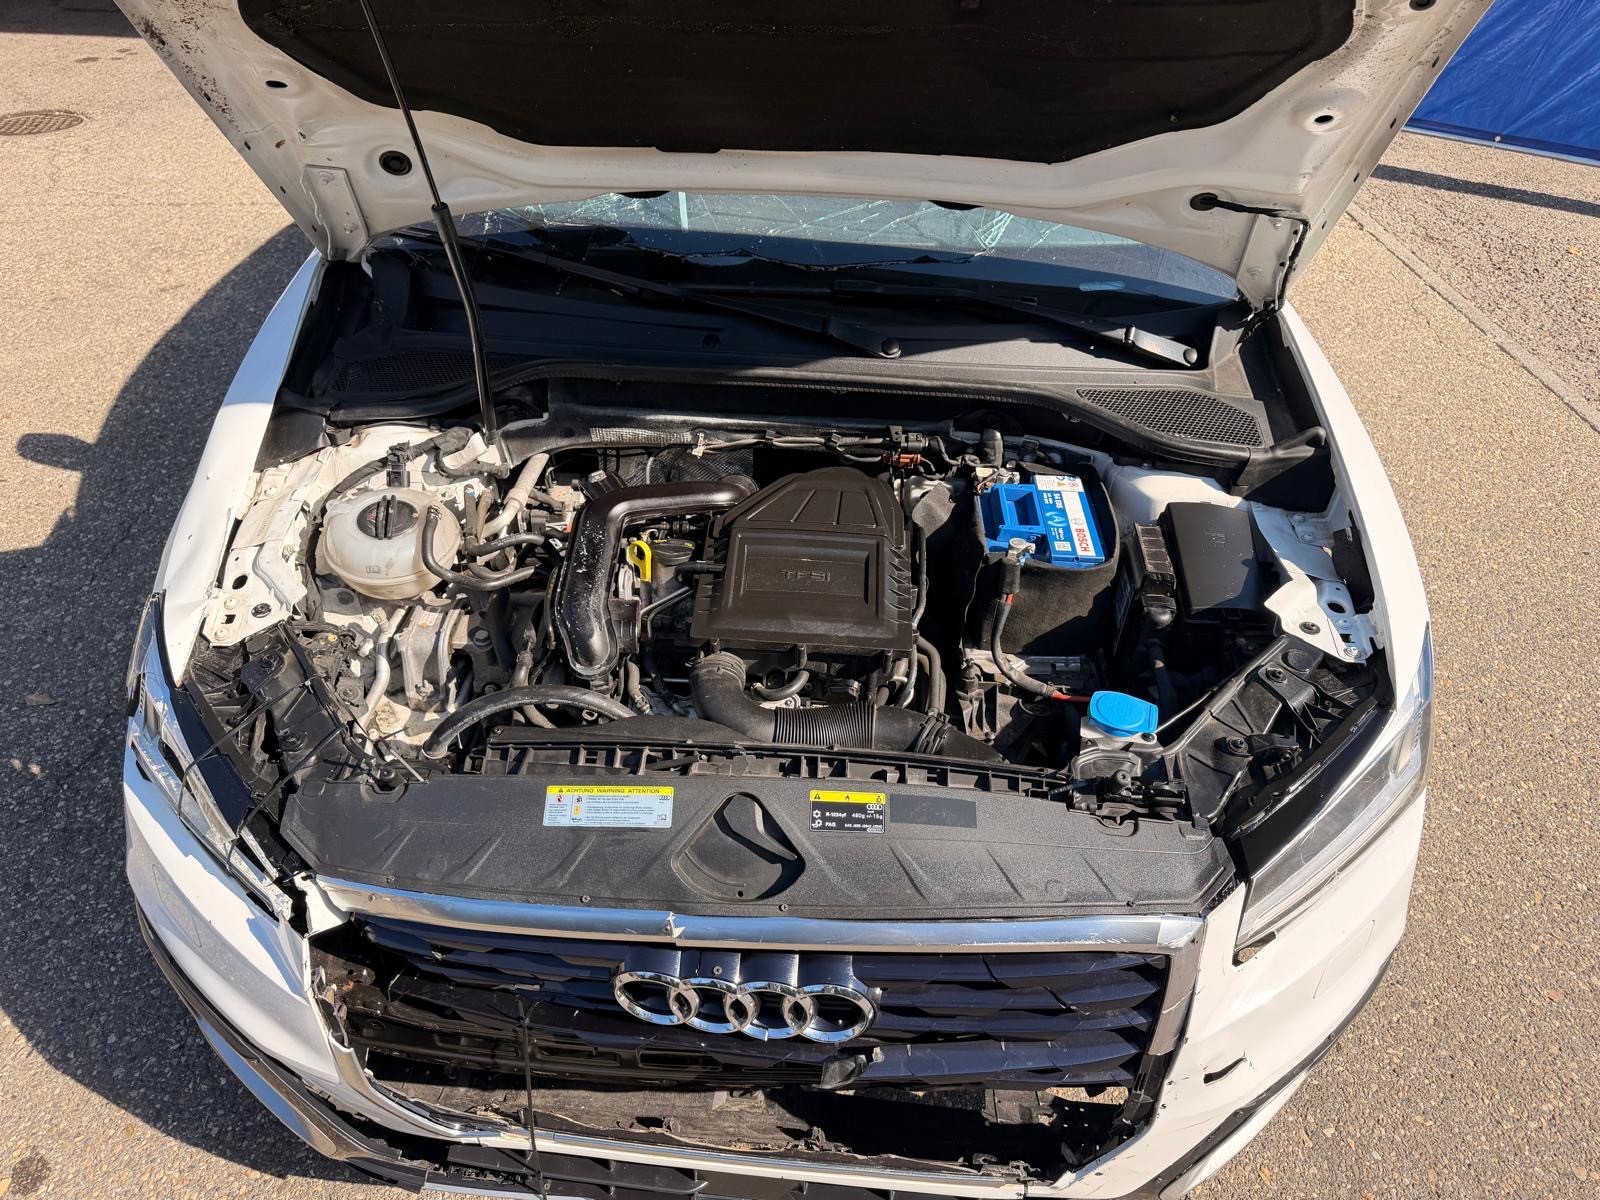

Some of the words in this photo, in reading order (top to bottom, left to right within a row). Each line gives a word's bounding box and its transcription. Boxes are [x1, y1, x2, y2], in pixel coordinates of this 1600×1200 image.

[1075, 528, 1090, 552] BOSCH
[780, 569, 831, 582] TFSI
[825, 811, 847, 819] R-1234yf
